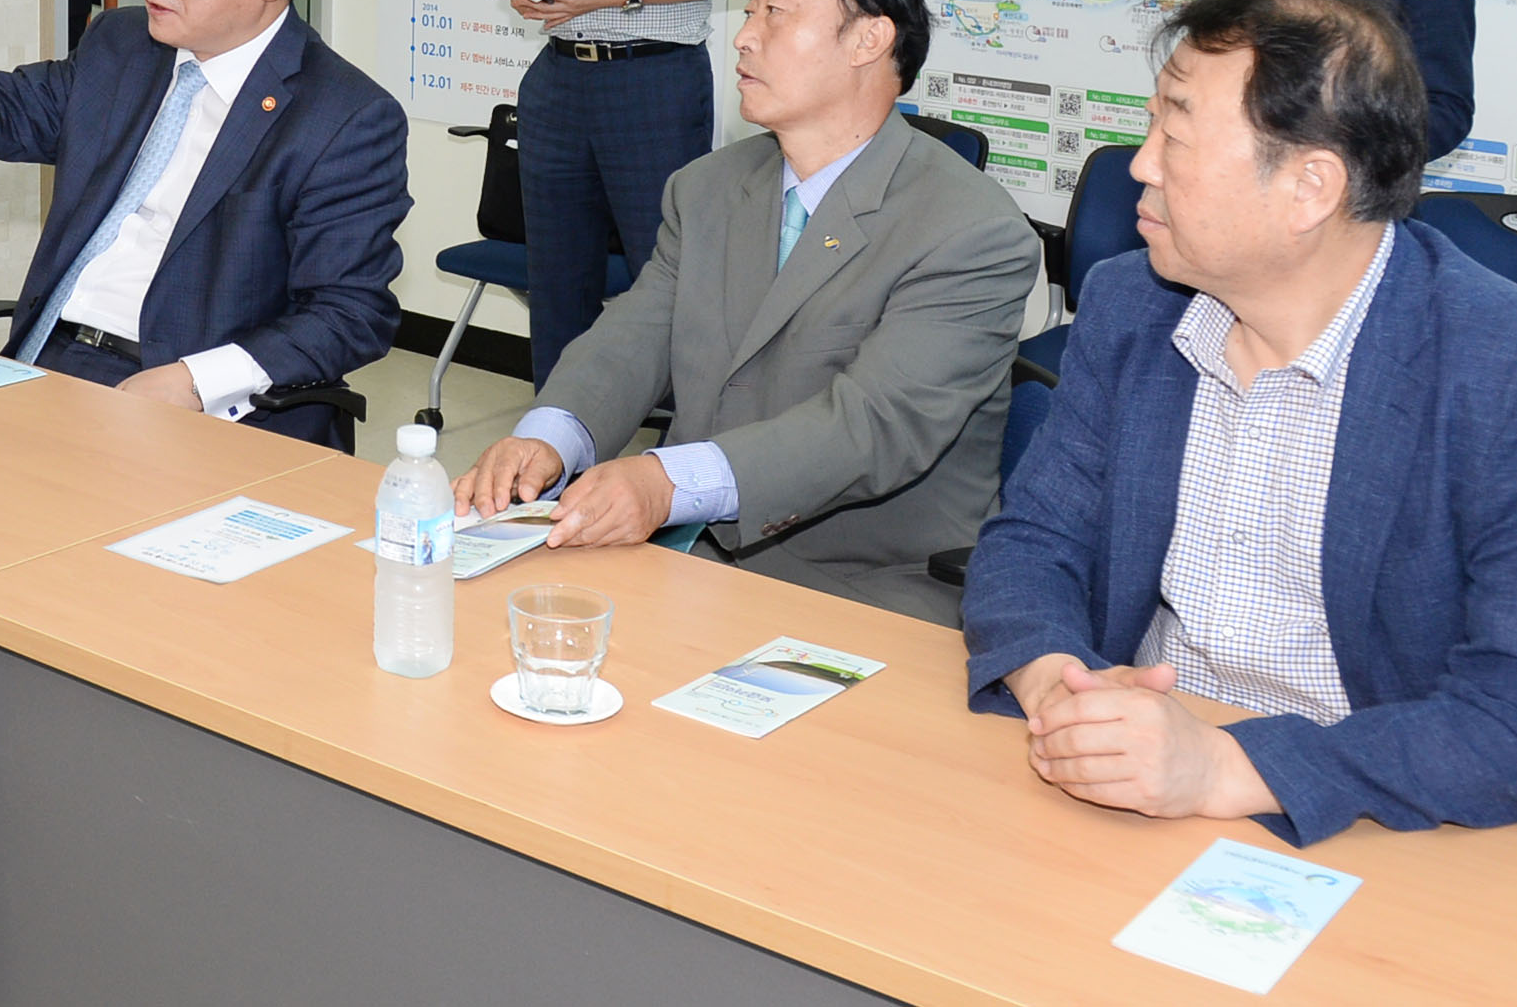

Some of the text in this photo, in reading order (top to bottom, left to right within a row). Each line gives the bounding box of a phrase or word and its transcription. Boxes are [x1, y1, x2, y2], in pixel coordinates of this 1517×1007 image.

[422, 3, 439, 12] 2014
[421, 14, 453, 30] 01.01
[460, 21, 471, 31] EV
[495, 24, 509, 35] 운영
[510, 27, 525, 38] 시작
[421, 42, 452, 58] 02.01
[460, 52, 471, 62] EV
[494, 57, 515, 67] 서비스
[421, 74, 452, 90] 12.01
[491, 86, 501, 96] EV
